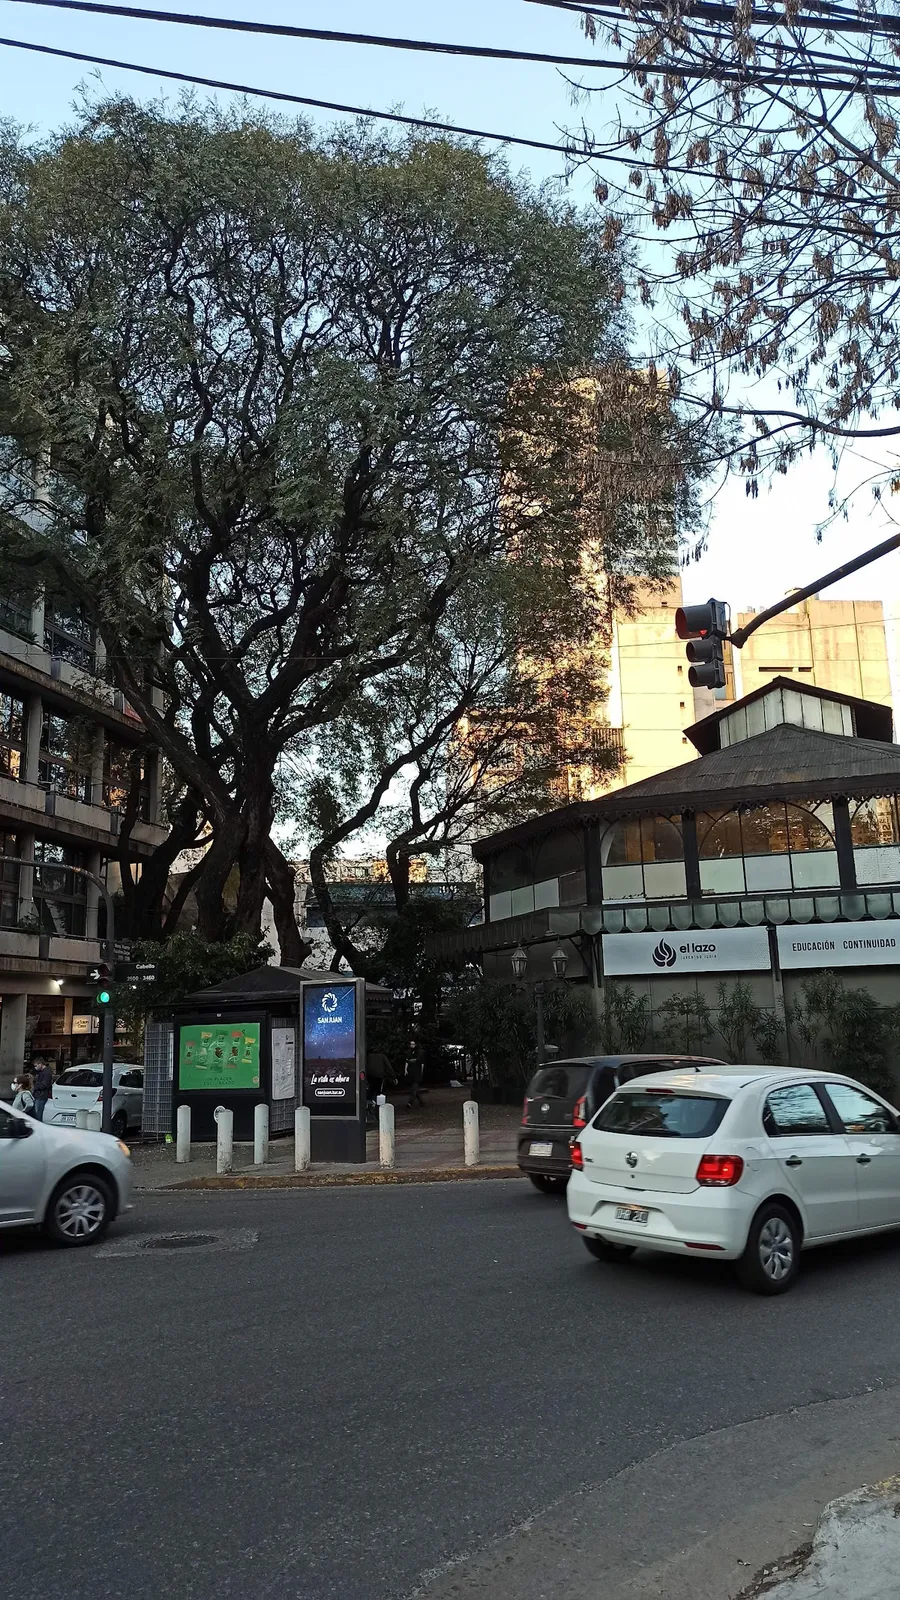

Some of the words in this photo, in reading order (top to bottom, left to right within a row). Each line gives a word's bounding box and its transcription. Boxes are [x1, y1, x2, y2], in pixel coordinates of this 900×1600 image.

[680, 943, 690, 953] el
[692, 943, 716, 953] lazo
[792, 940, 835, 951] EDUCACIÓN
[843, 939, 896, 949] CONTINUIDAD
[311, 1074, 318, 1085] La
